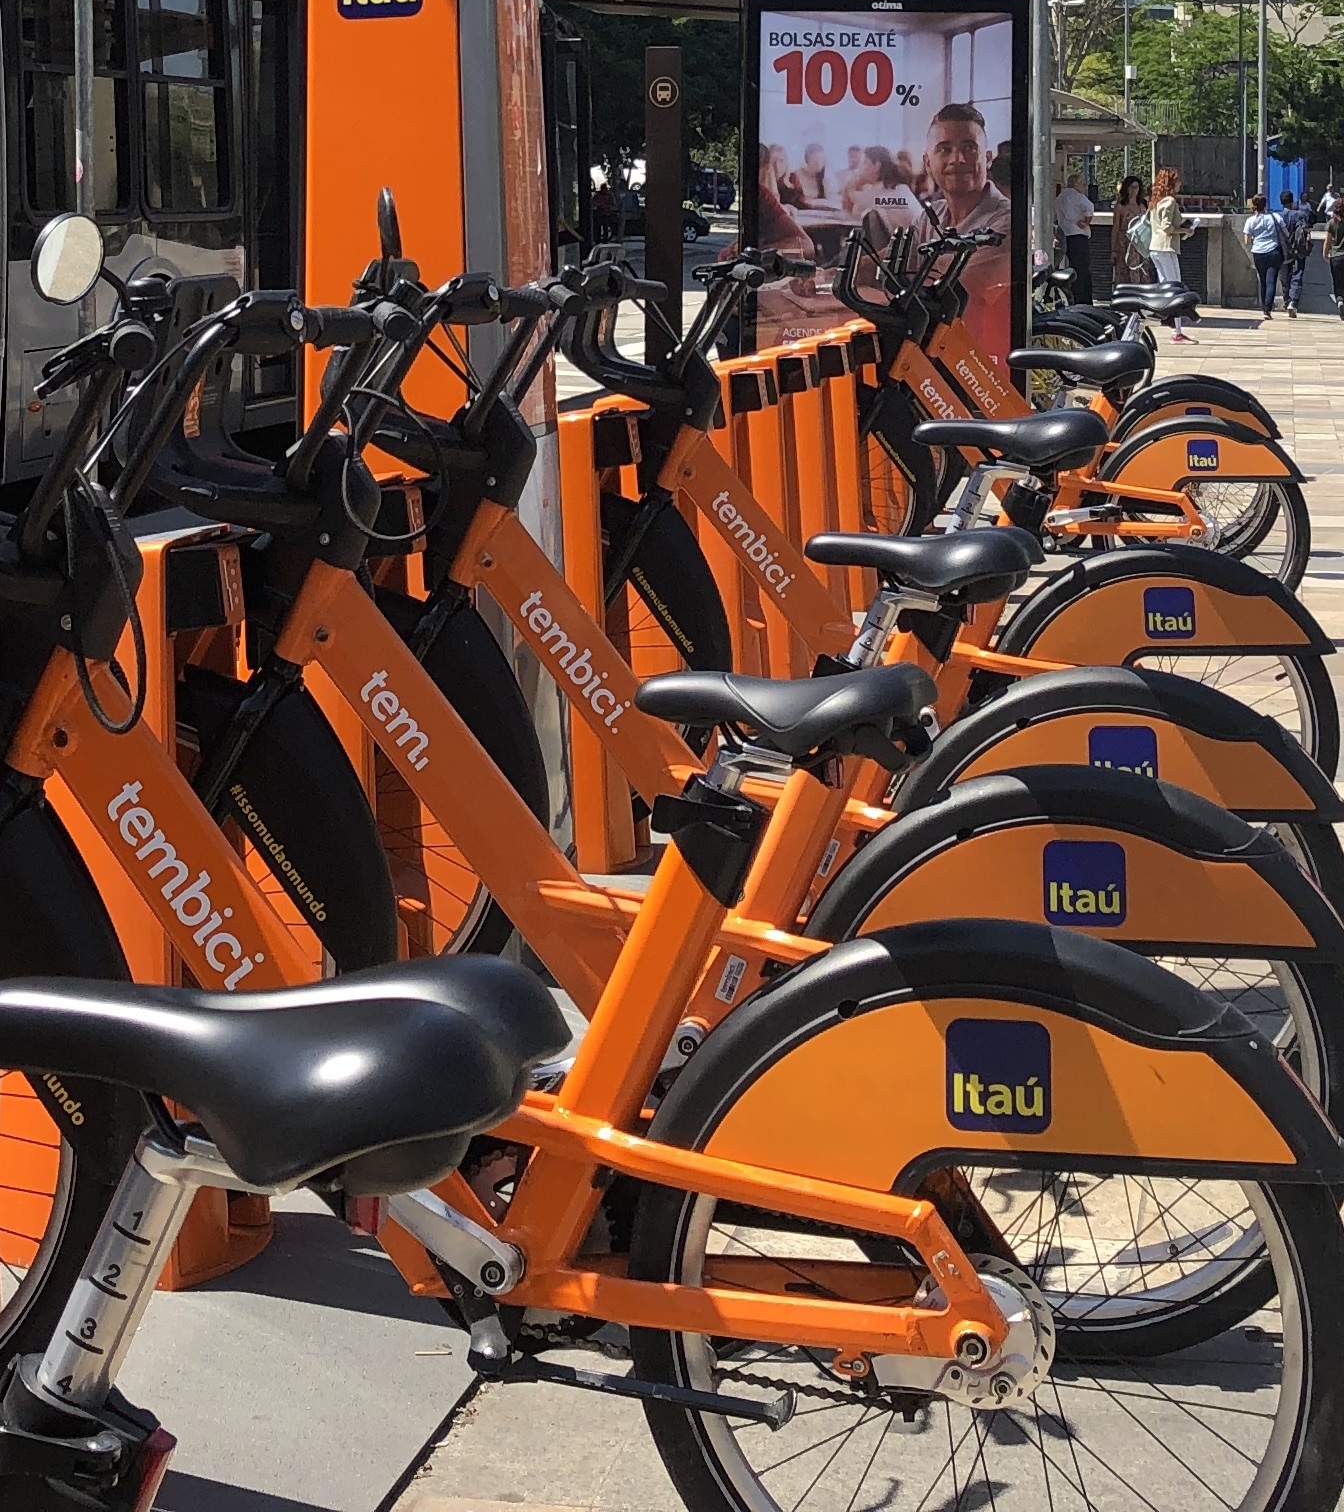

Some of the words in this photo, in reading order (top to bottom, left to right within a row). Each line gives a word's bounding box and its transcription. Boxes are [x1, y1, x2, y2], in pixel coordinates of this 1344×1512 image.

[768, 31, 836, 48] BOLSAS
[839, 31, 862, 48] DE
[864, 29, 897, 48] ATÉ
[874, 197, 909, 206] RAFAEL
[1189, 454, 1217, 467] Itaú
[1147, 611, 1192, 631] Itaú
[229, 783, 327, 922] #issomudaomundo
[1049, 882, 1121, 914] Itaú
[953, 1073, 1044, 1117] Itaú
